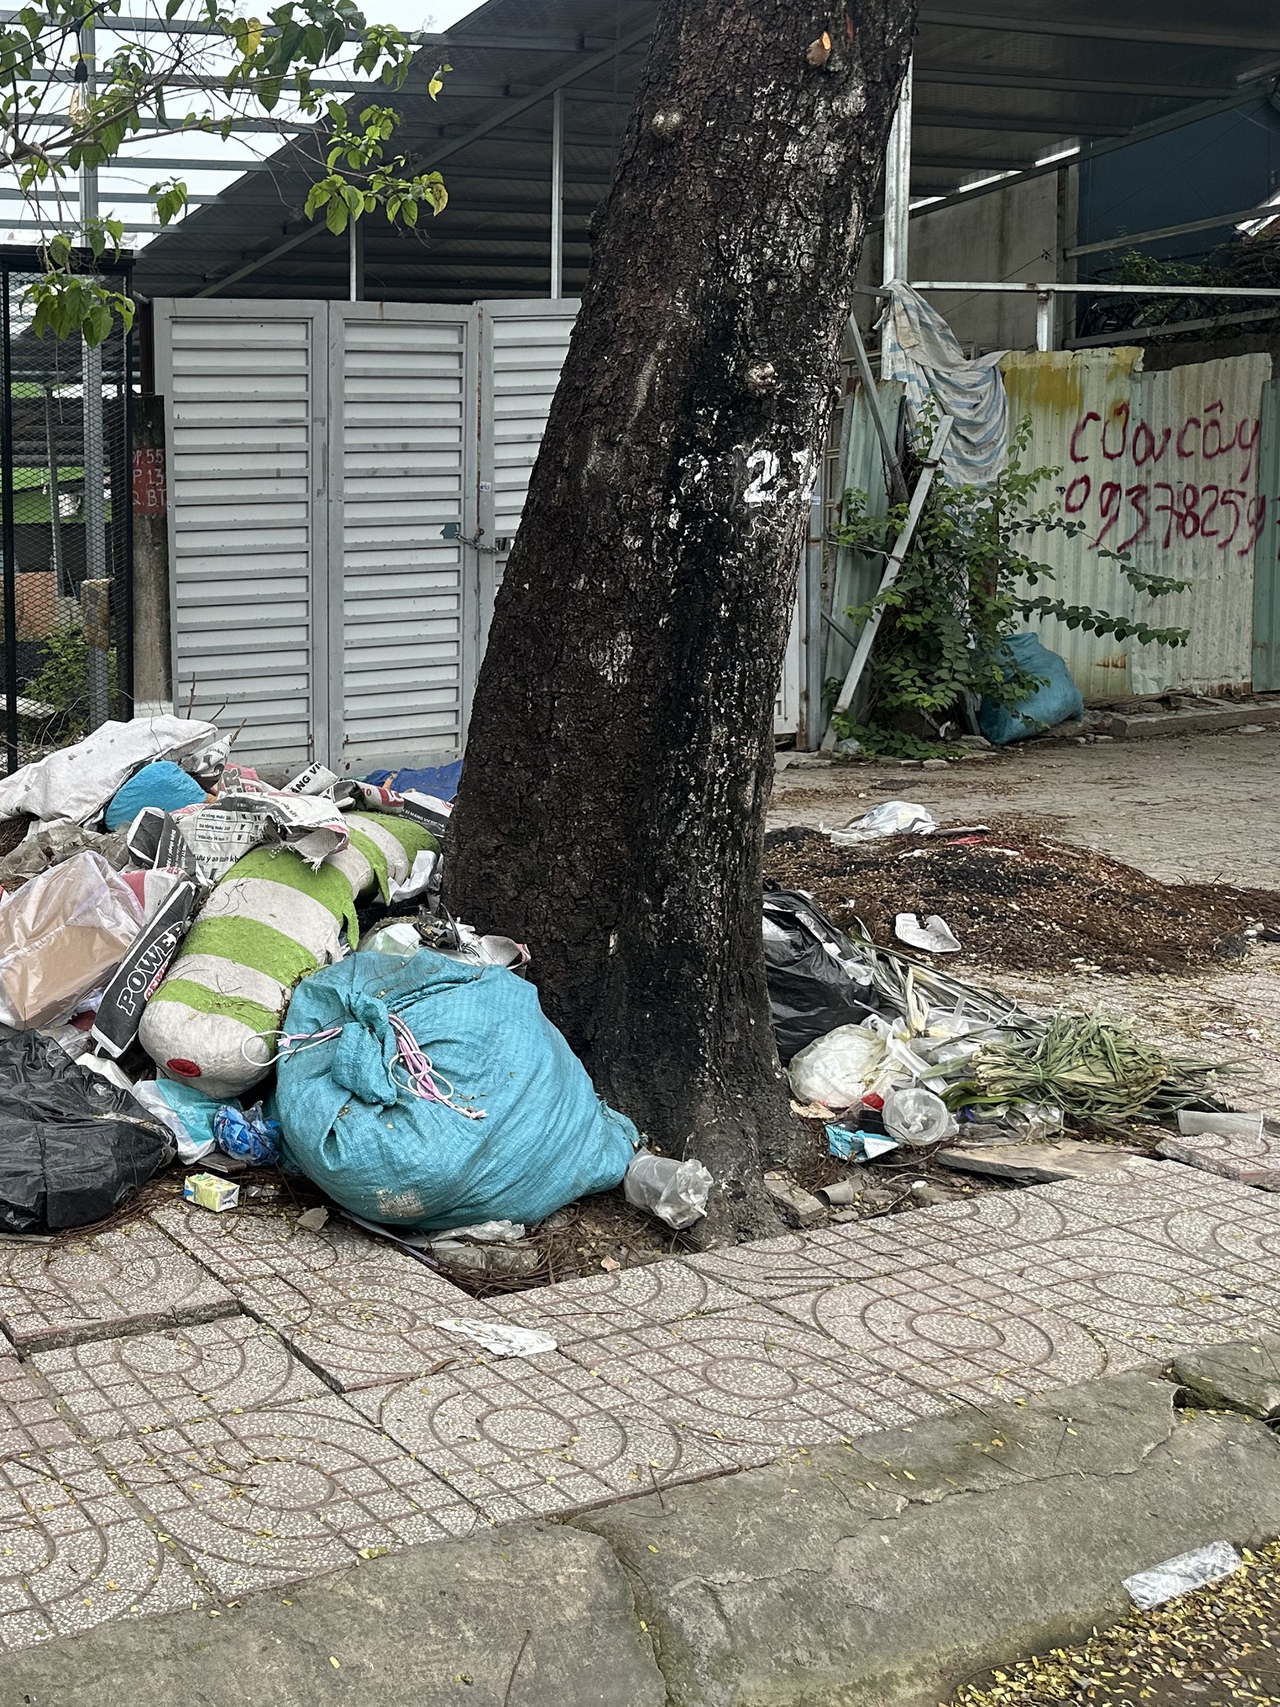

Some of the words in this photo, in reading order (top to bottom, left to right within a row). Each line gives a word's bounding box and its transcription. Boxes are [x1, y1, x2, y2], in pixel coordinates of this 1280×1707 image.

[1065, 474, 1280, 556] 09378259
[290, 775, 312, 793] ĂNG
[116, 921, 184, 1017] POWER
